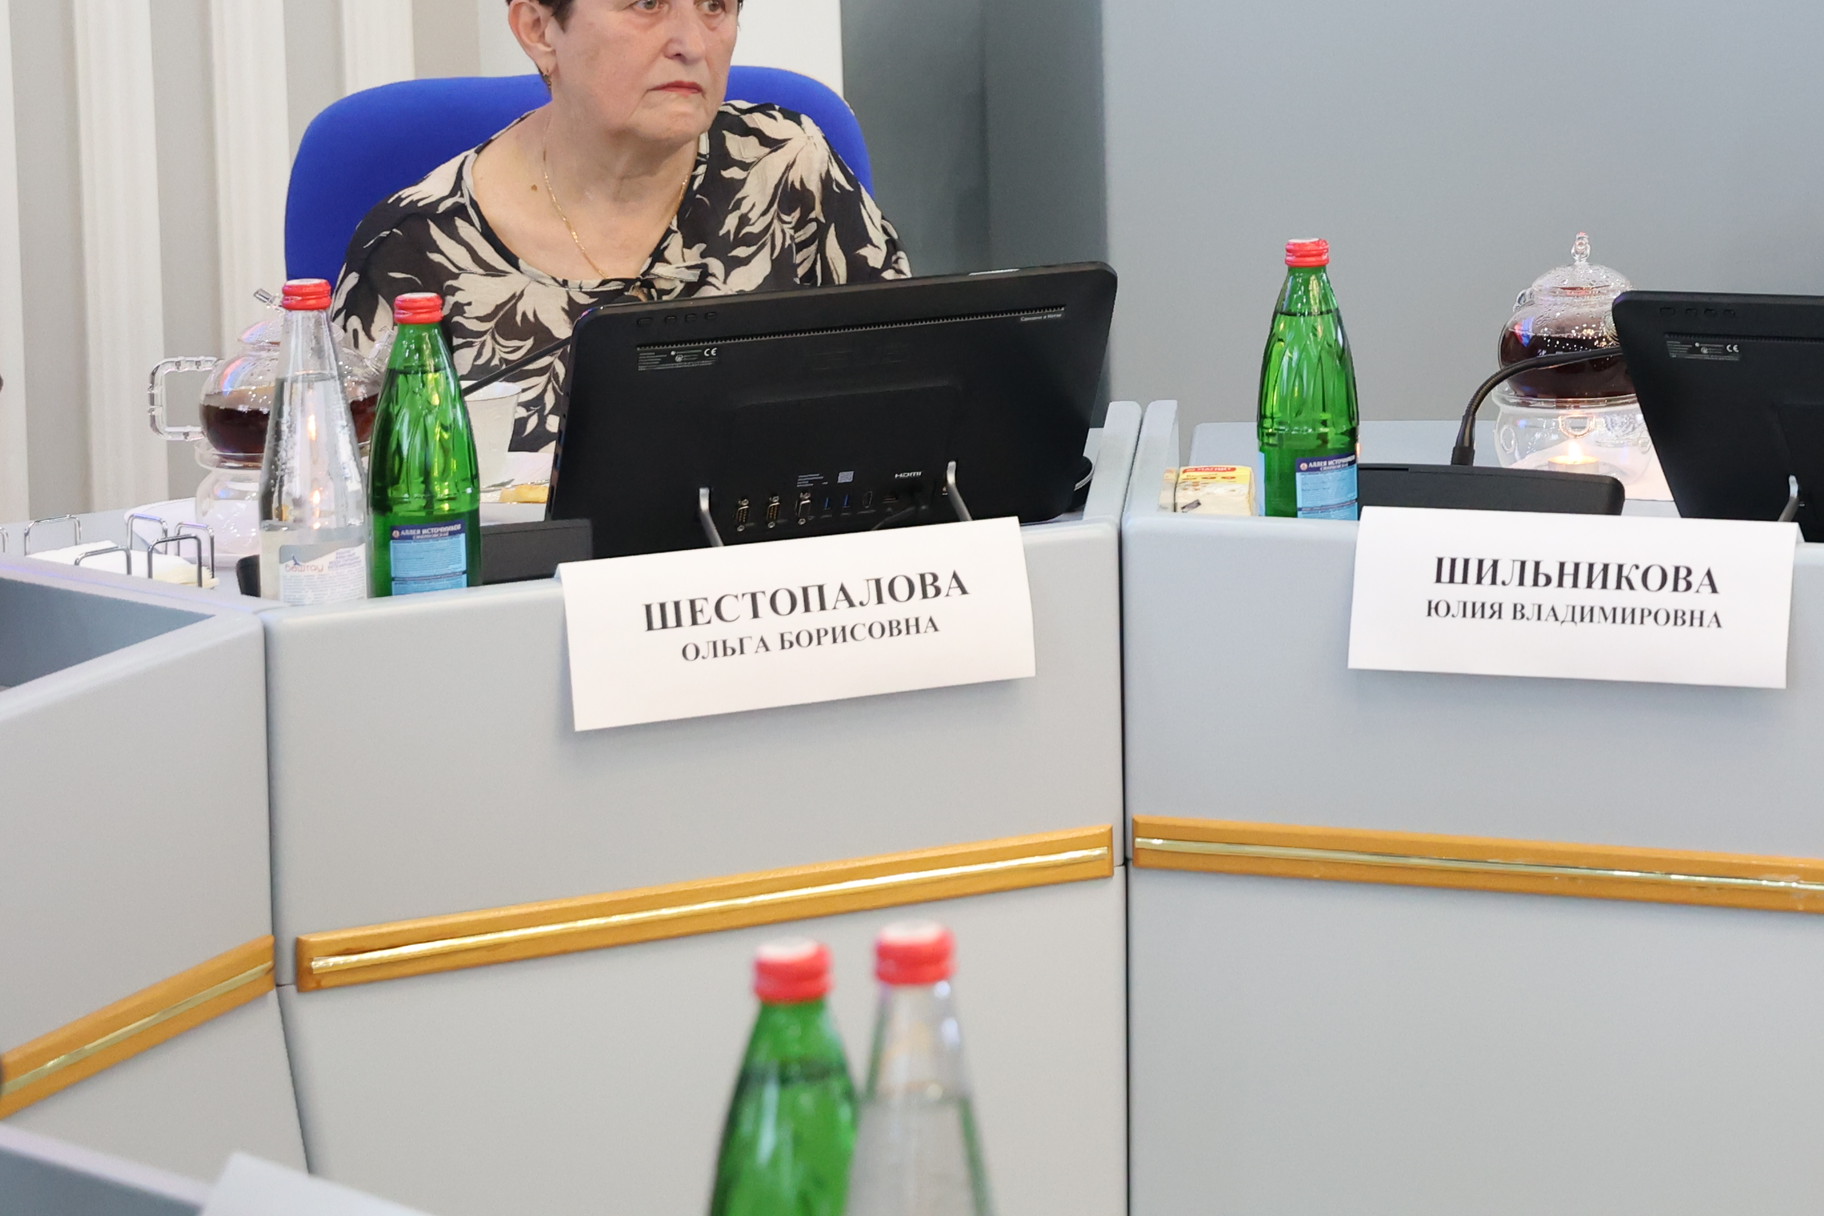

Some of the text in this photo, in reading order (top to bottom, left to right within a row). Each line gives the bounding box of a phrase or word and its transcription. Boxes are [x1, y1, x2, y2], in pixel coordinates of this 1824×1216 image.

[894, 471, 922, 479] HDMI
[1434, 556, 1720, 595] ШИЛЬНИКОВА
[642, 569, 970, 633] ШЕСТОПАЛОВА
[1426, 599, 1723, 629] ЮЛИЯ ВЛАДИМИРОВНА
[681, 615, 940, 662] ОЛЬГА БОРИСОВНА
